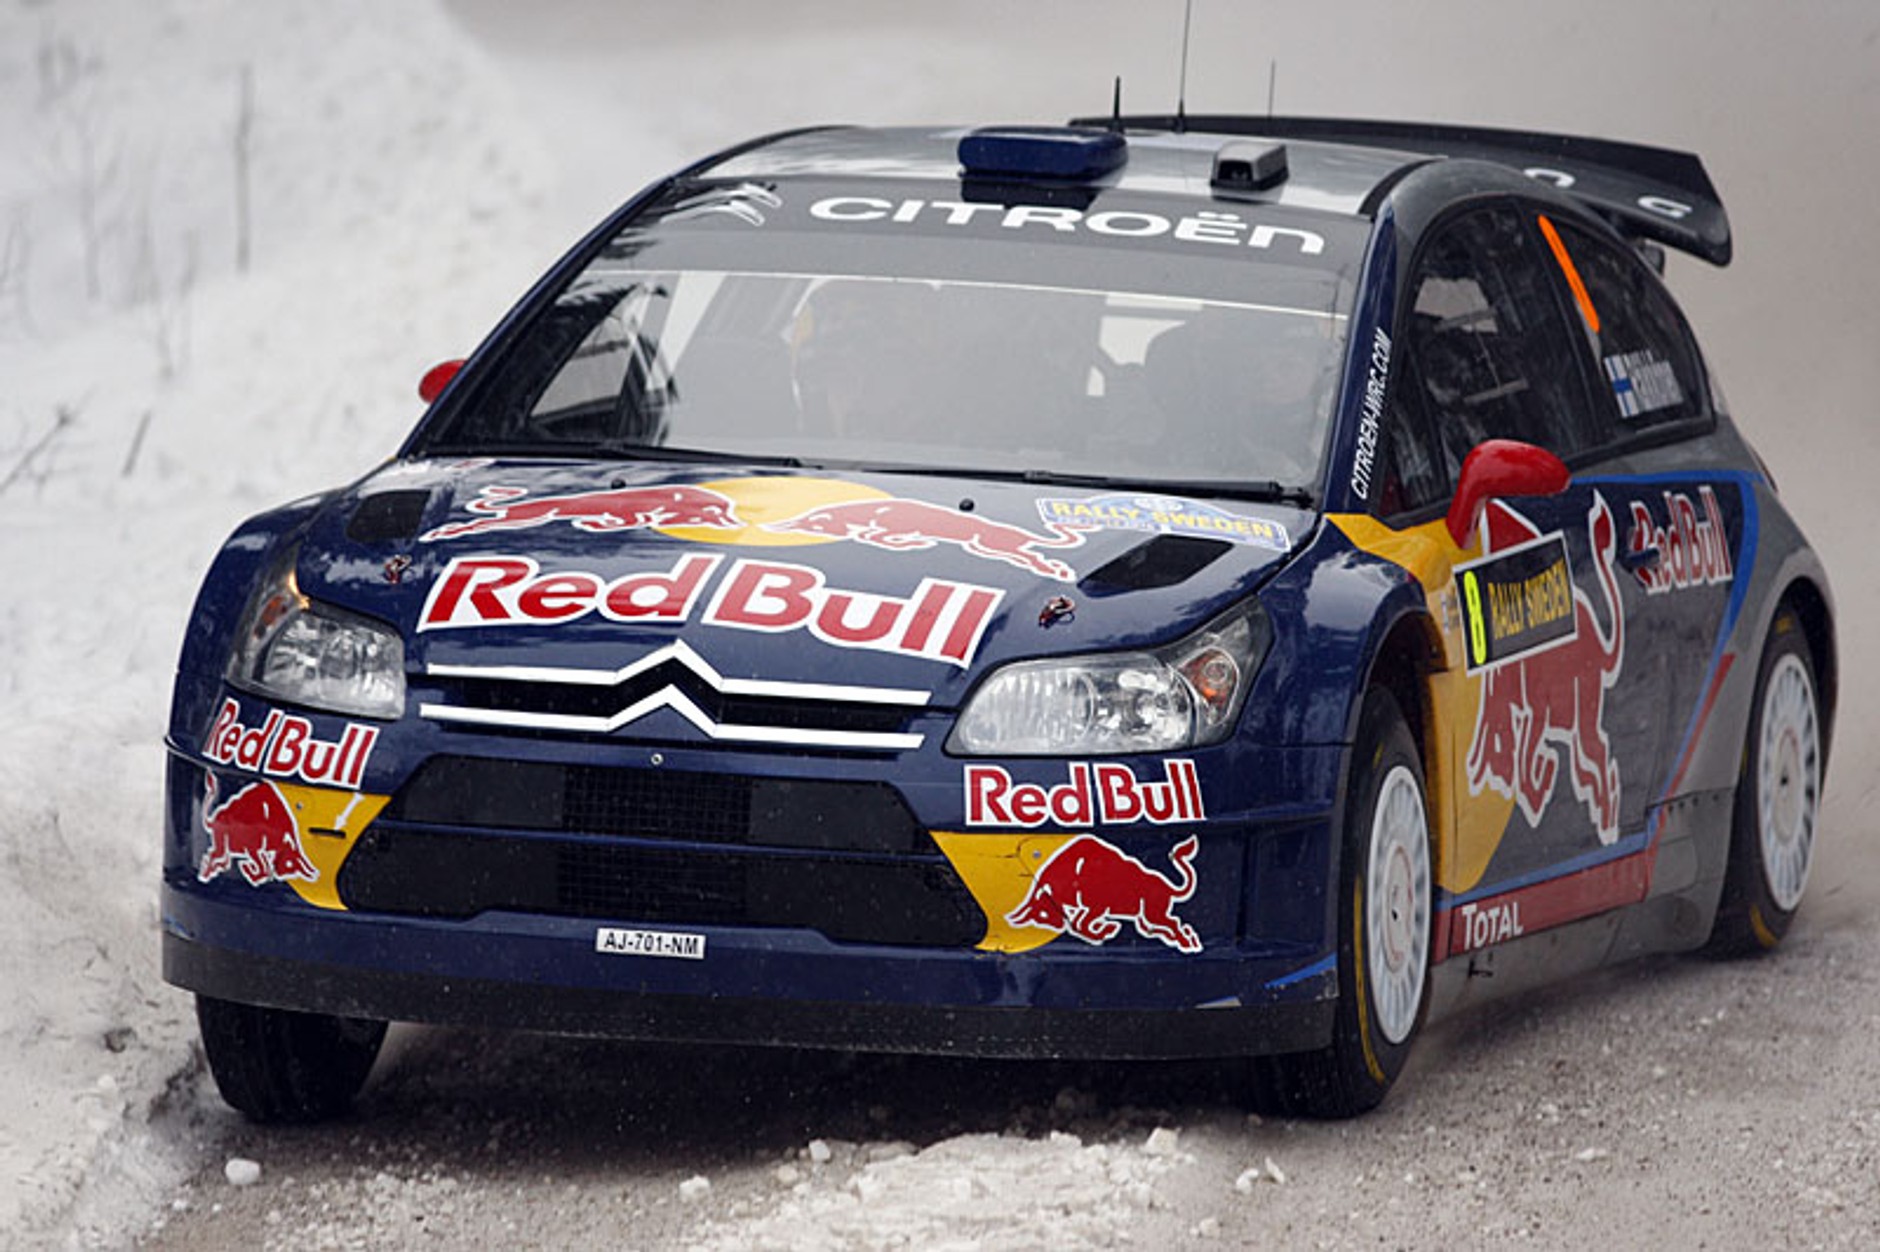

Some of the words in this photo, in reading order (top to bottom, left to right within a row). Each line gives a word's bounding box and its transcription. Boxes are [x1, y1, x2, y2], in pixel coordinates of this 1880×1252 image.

[1051, 500, 1140, 519] RALLY
[1151, 512, 1273, 538] SWEDEN
[1674, 485, 1733, 585] Bull
[418, 554, 724, 630] Red
[703, 559, 1004, 667] Bull
[1464, 571, 1486, 665] 8
[1488, 582, 1525, 639] RALLY
[202, 697, 285, 771] Red
[263, 715, 380, 790] Bull
[964, 762, 1094, 827] Red
[1093, 759, 1207, 824] Bull
[605, 932, 698, 954] AJ-701-NM
